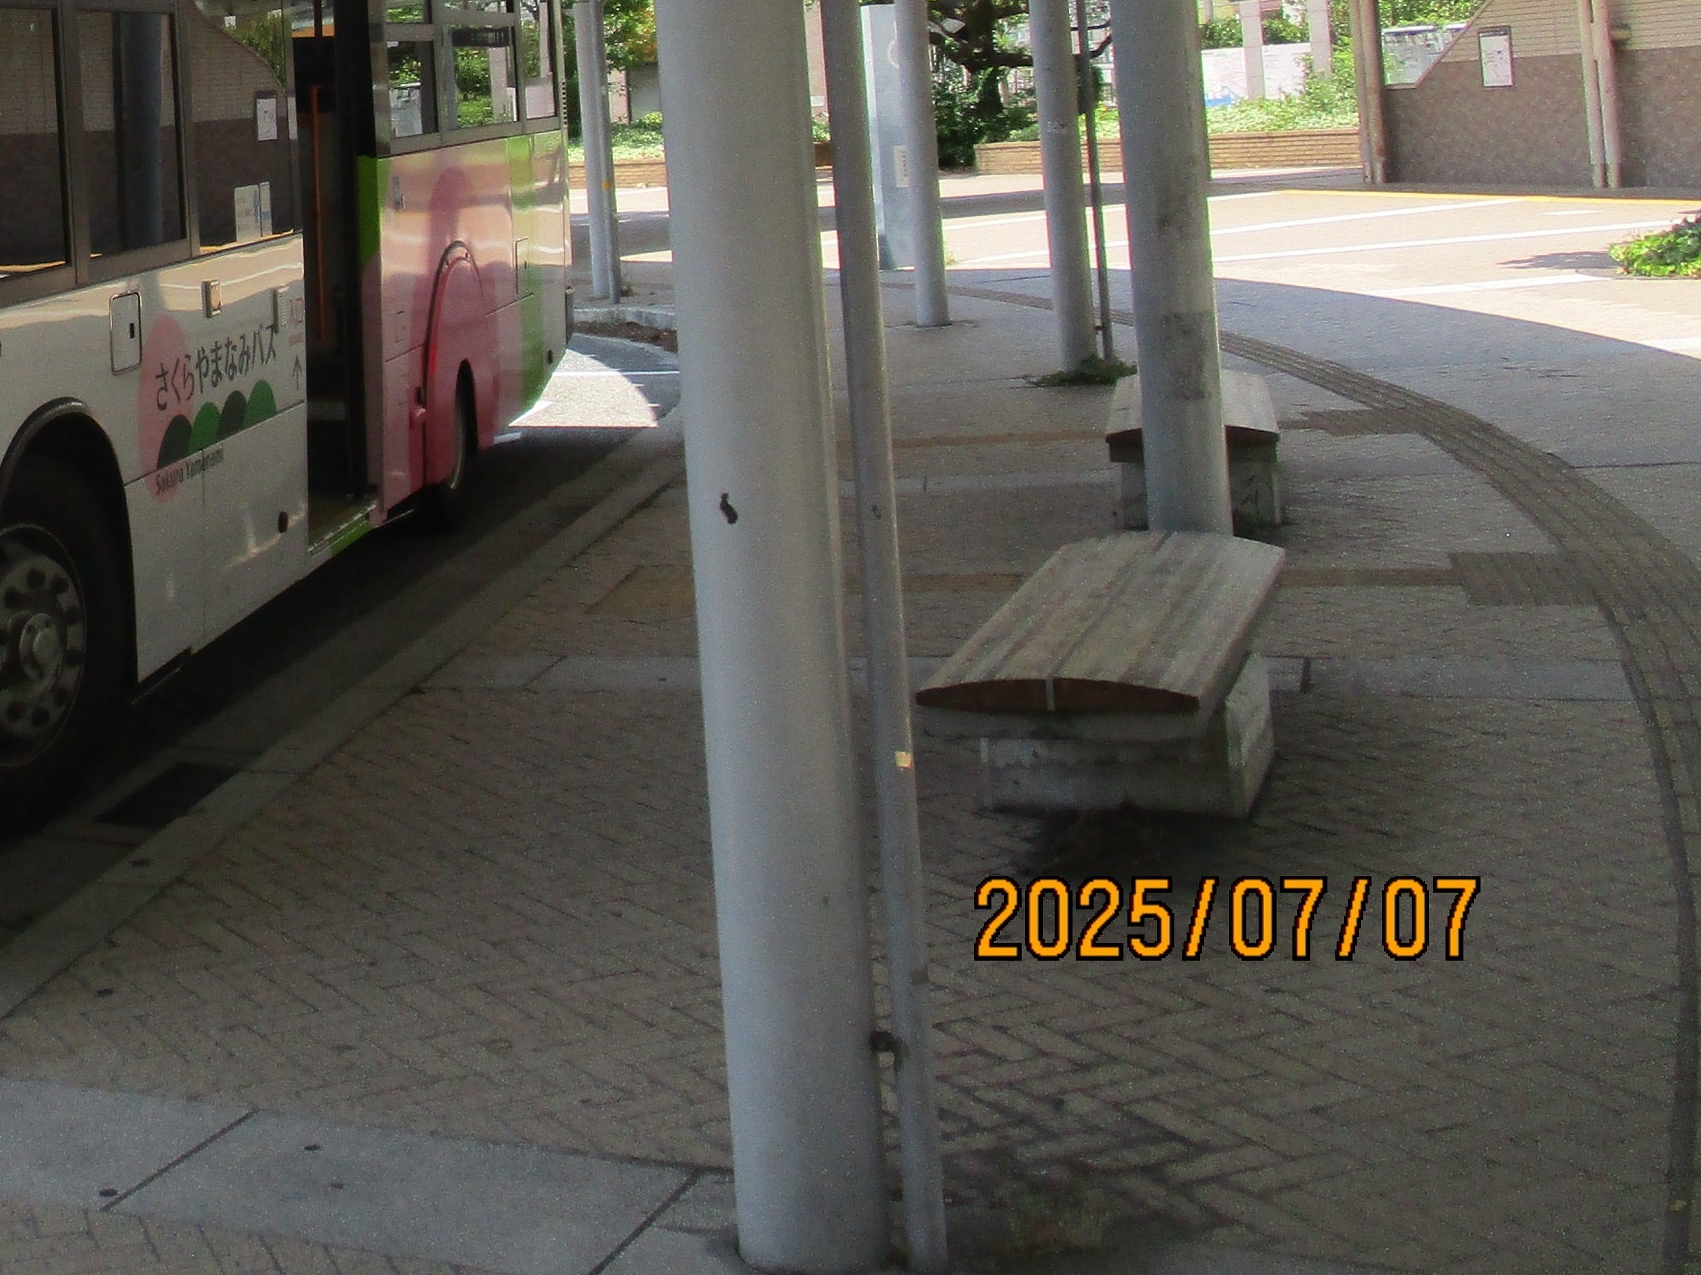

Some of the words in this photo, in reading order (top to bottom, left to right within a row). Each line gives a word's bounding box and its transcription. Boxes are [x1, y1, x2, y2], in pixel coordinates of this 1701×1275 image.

[156, 324, 277, 410] さくらやまなみバス
